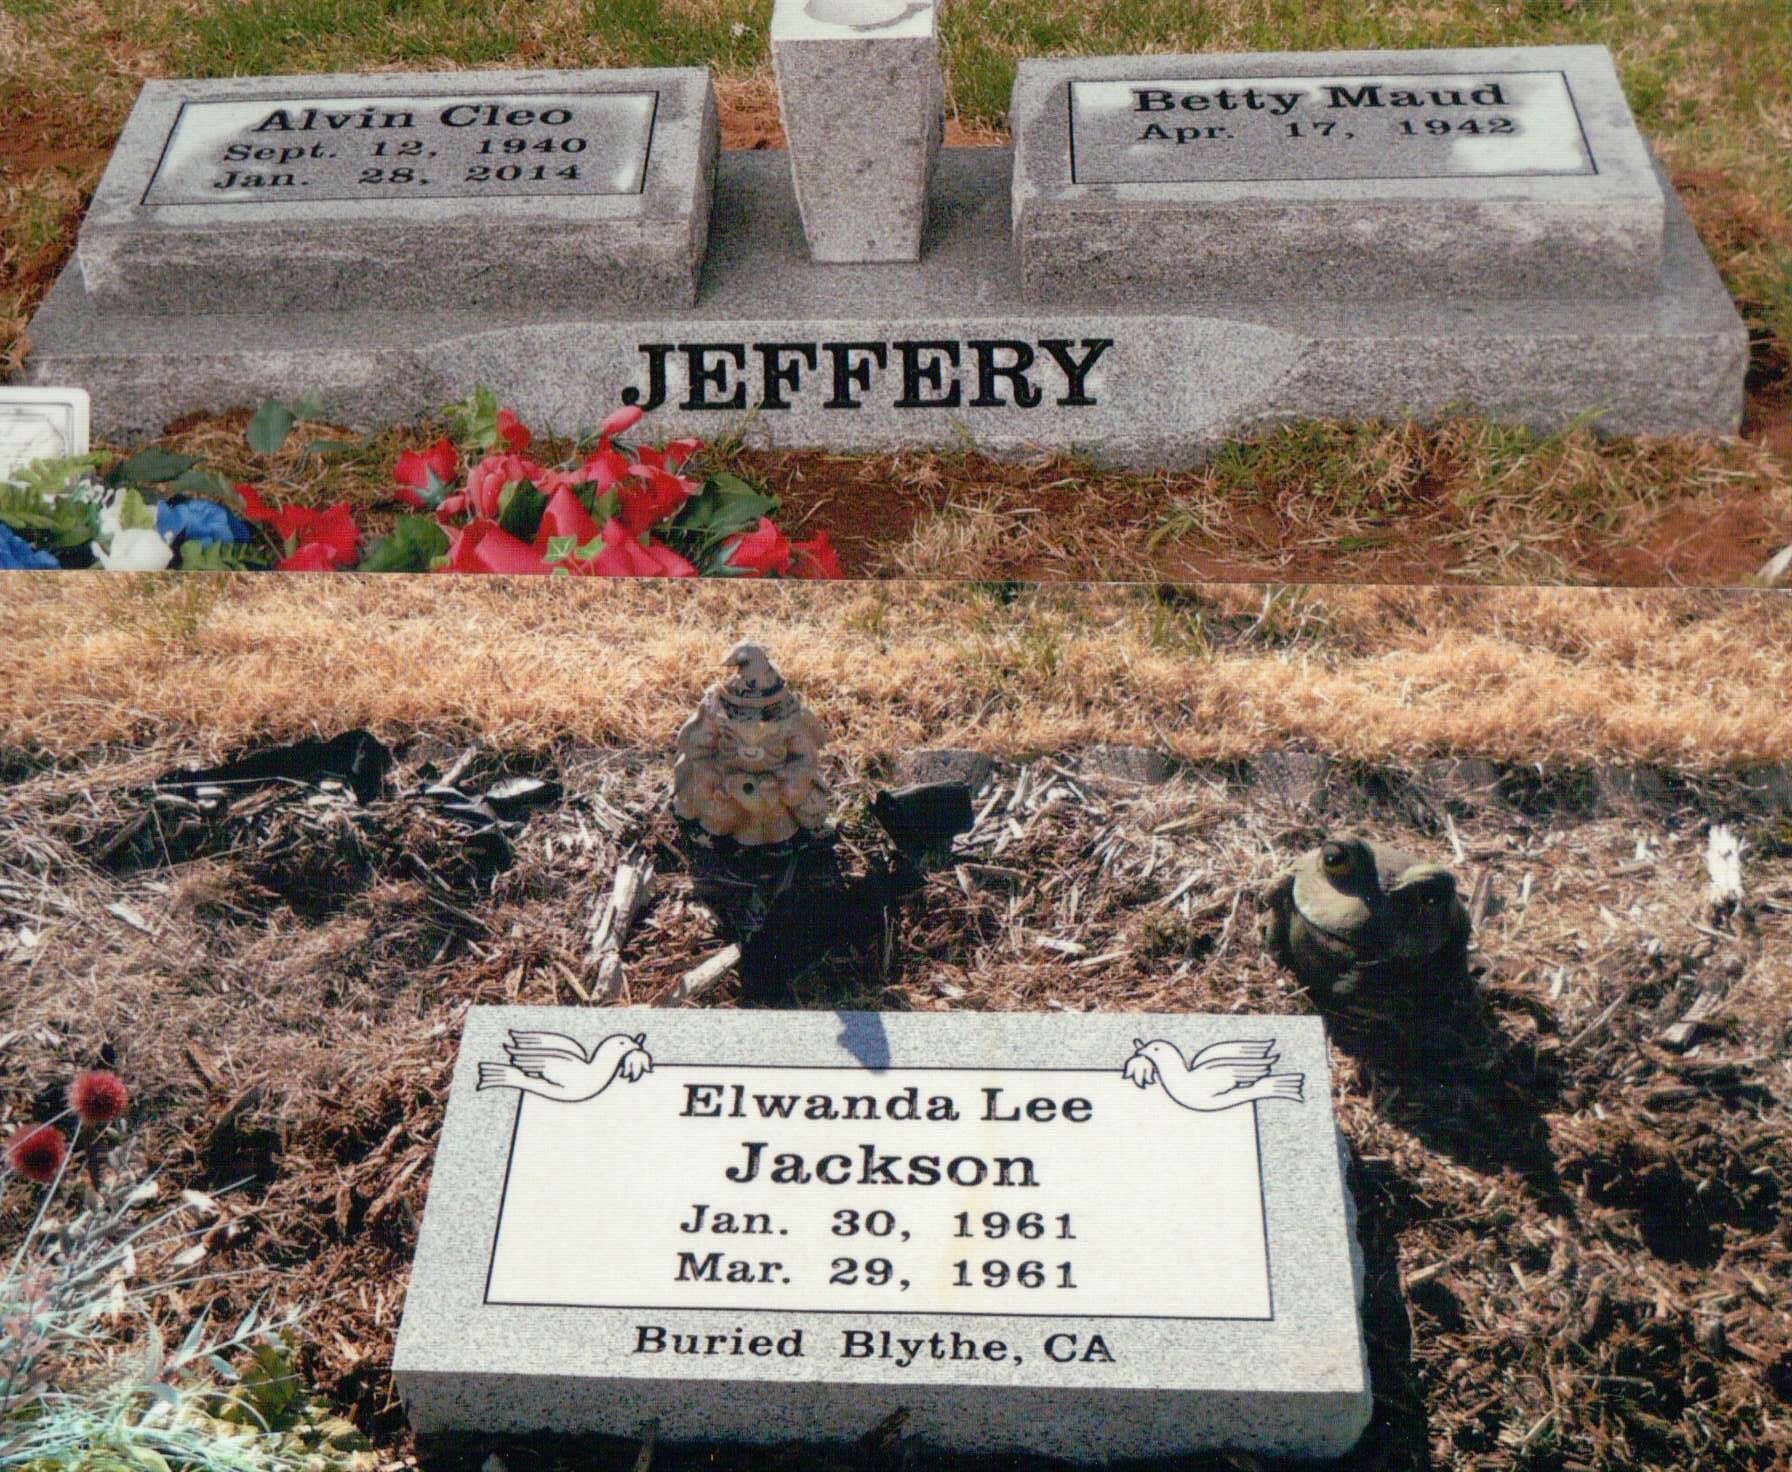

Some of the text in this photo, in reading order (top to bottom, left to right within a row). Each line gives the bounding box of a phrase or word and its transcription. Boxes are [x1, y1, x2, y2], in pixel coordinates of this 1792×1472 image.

[252, 103, 573, 132] Alvin Cleo
[1133, 84, 1510, 116] Betty Maud
[1138, 118, 1514, 144] Apr. 17, 1942
[224, 141, 336, 163] Sept.
[476, 138, 587, 155] 1940
[214, 170, 310, 189] Jan.
[465, 164, 580, 182] 2014
[622, 339, 1114, 412] JEFFERY
[680, 1084, 1092, 1122] Elwanda Lee
[726, 1142, 1040, 1186] Jackson
[680, 1205, 1076, 1242] Jan. 30, 1961
[674, 1252, 1077, 1291] Mar. 29, 1961
[633, 1326, 1116, 1367] Buried Blythe, CA
